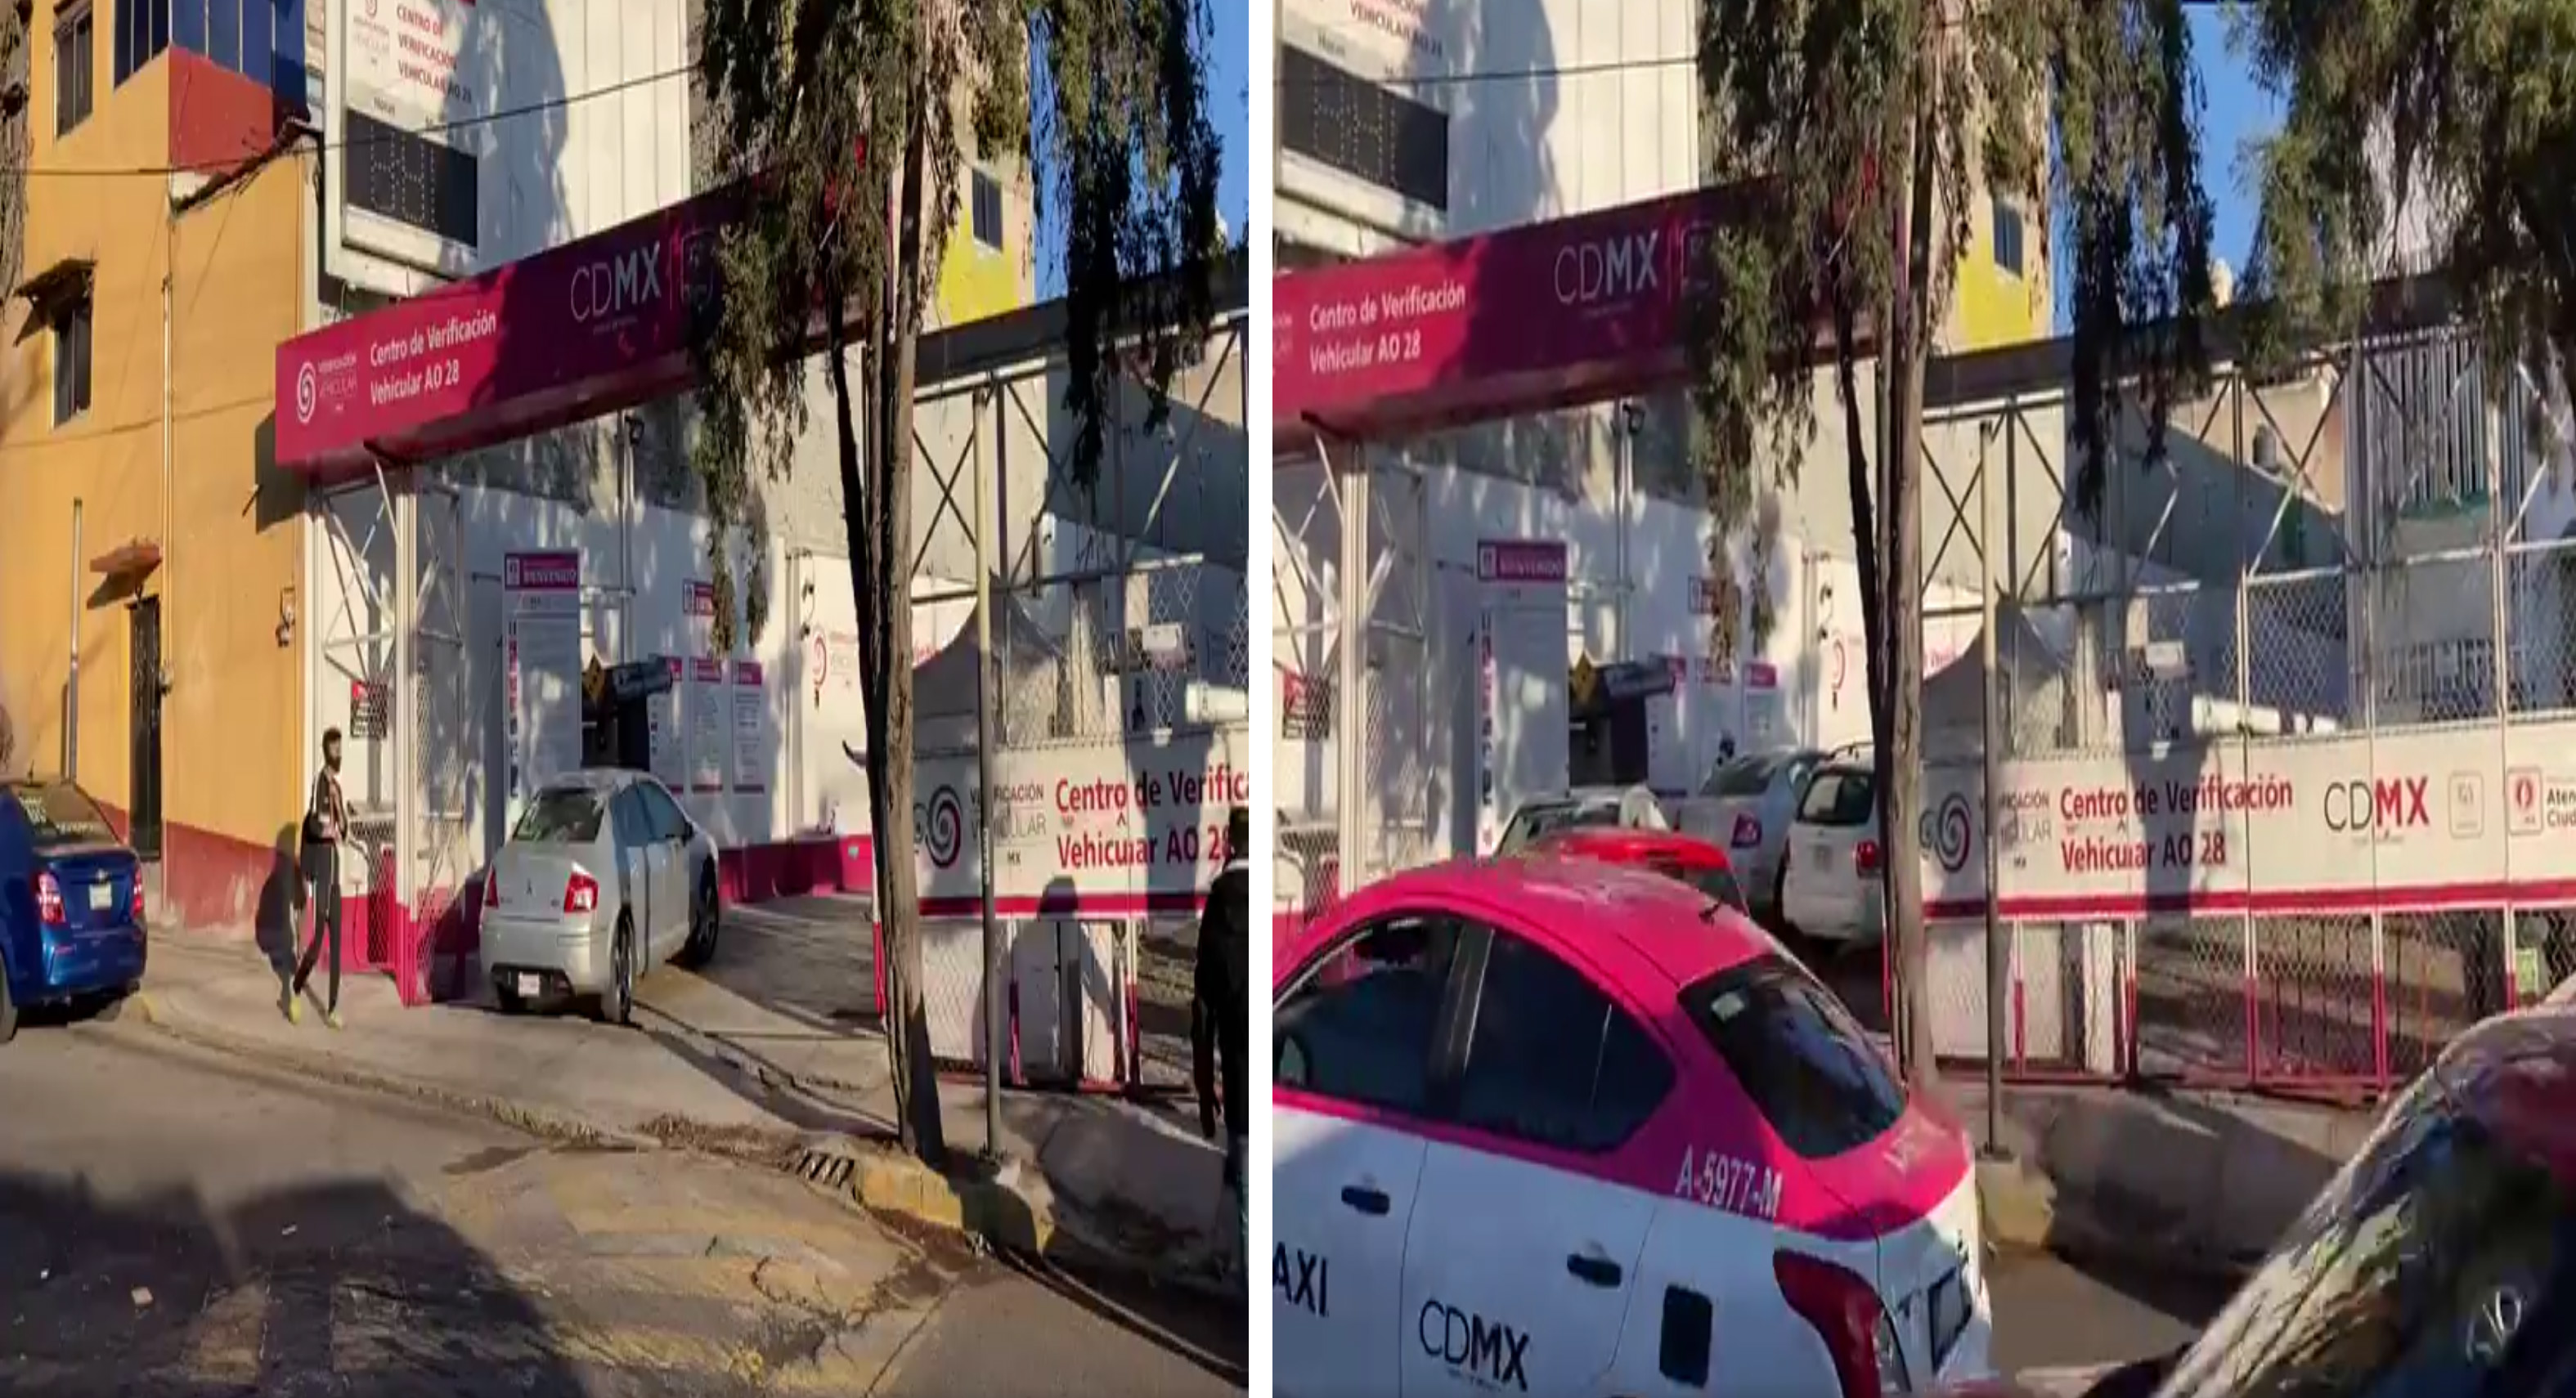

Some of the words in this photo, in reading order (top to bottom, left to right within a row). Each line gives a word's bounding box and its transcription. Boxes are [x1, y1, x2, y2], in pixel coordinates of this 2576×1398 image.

[570, 240, 661, 322] CDMX
[1554, 227, 1657, 305] CDMX
[1310, 302, 1356, 331] Centro
[1359, 293, 1377, 322] de
[1381, 279, 1465, 320] Verificación
[370, 339, 407, 367] Centro
[410, 329, 424, 354] de
[427, 310, 496, 349] Verificación
[1310, 339, 1372, 374] Vehicular
[1377, 334, 1400, 363] AO
[1403, 329, 1421, 358] 28
[370, 371, 422, 406] Vehicular
[424, 365, 442, 392] AO
[445, 358, 460, 386] 28
[1055, 777, 1127, 814] Centro
[1135, 772, 1161, 808] de
[2060, 787, 2127, 821] Centro
[2134, 777, 2158, 813] de
[2165, 771, 2294, 813] Verificación
[2324, 776, 2430, 831] CDMX
[1057, 828, 1159, 870] Vehicular
[1165, 823, 1200, 864] AO
[2061, 836, 2154, 872] Vehicular
[2163, 835, 2192, 865] AO
[2200, 832, 2226, 867] 28
[1674, 1145, 1784, 1219] A-5977-M
[1419, 1298, 1530, 1392] CDMX
